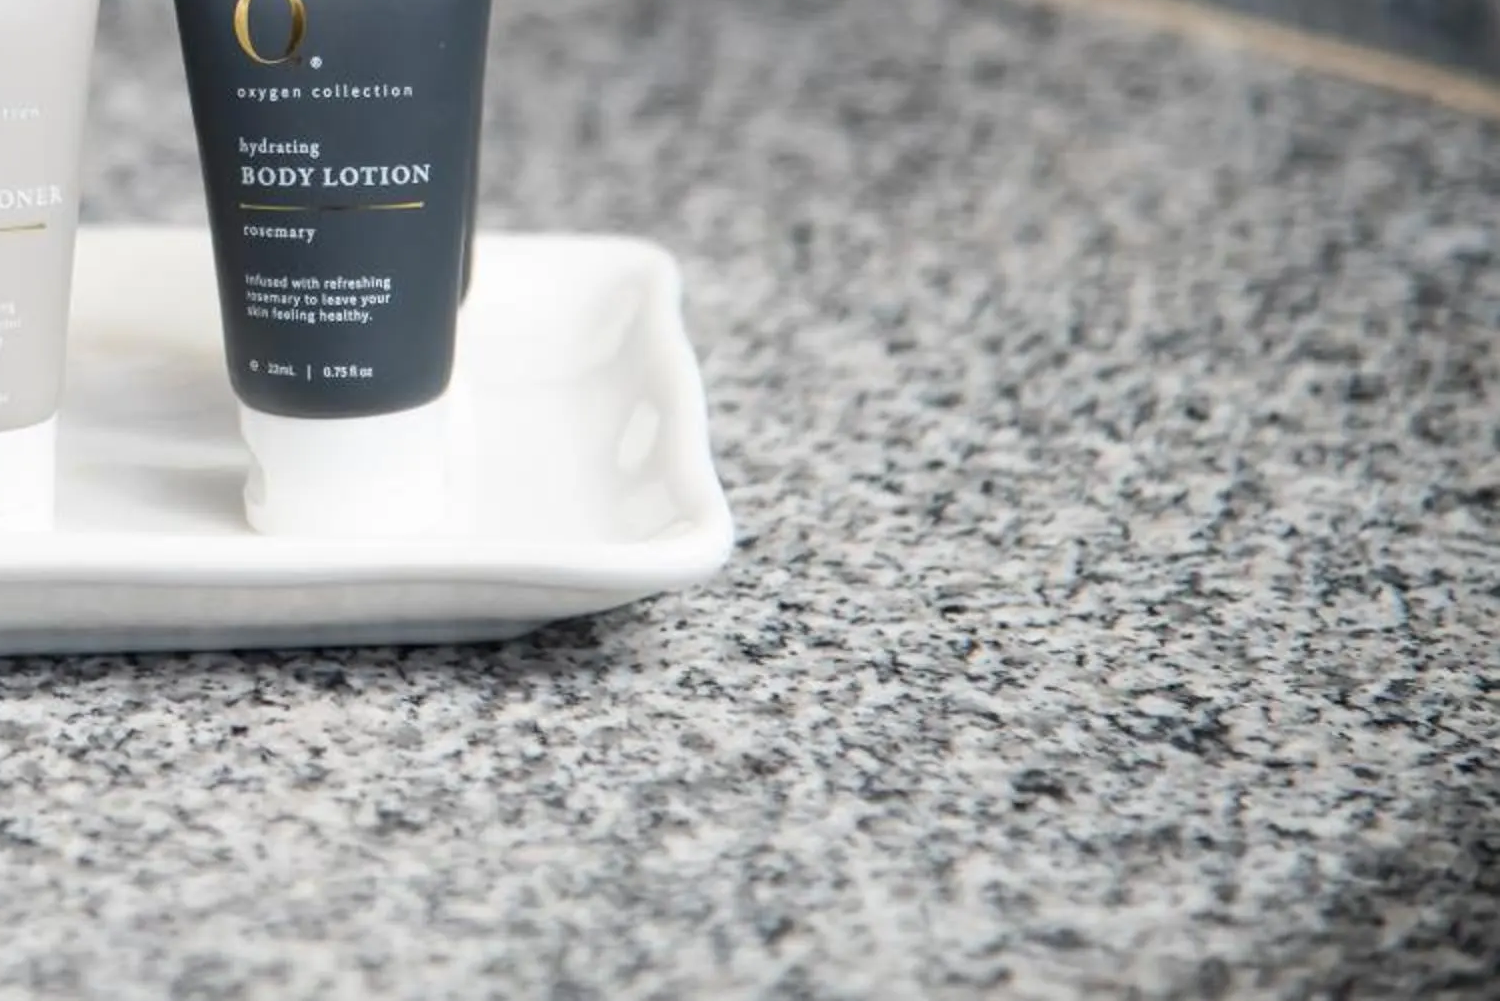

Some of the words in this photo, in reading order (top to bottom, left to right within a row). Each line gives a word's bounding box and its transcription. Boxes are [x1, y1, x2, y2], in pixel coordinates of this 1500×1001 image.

[237, 86, 301, 102] oxygen
[311, 83, 413, 99] collection
[239, 136, 320, 159] hydrating
[240, 165, 315, 187] BODY
[322, 163, 431, 187] LOTION
[243, 225, 317, 244] rosemary
[291, 276, 320, 290] with
[323, 275, 391, 292] refreshing
[246, 290, 301, 308] rosemary
[304, 294, 318, 306] to
[321, 293, 357, 306] leave
[360, 293, 391, 308] your
[246, 305, 269, 320] skin
[272, 307, 316, 324] feeling
[319, 308, 373, 324] healthy.
[323, 365, 348, 378] 0.75
